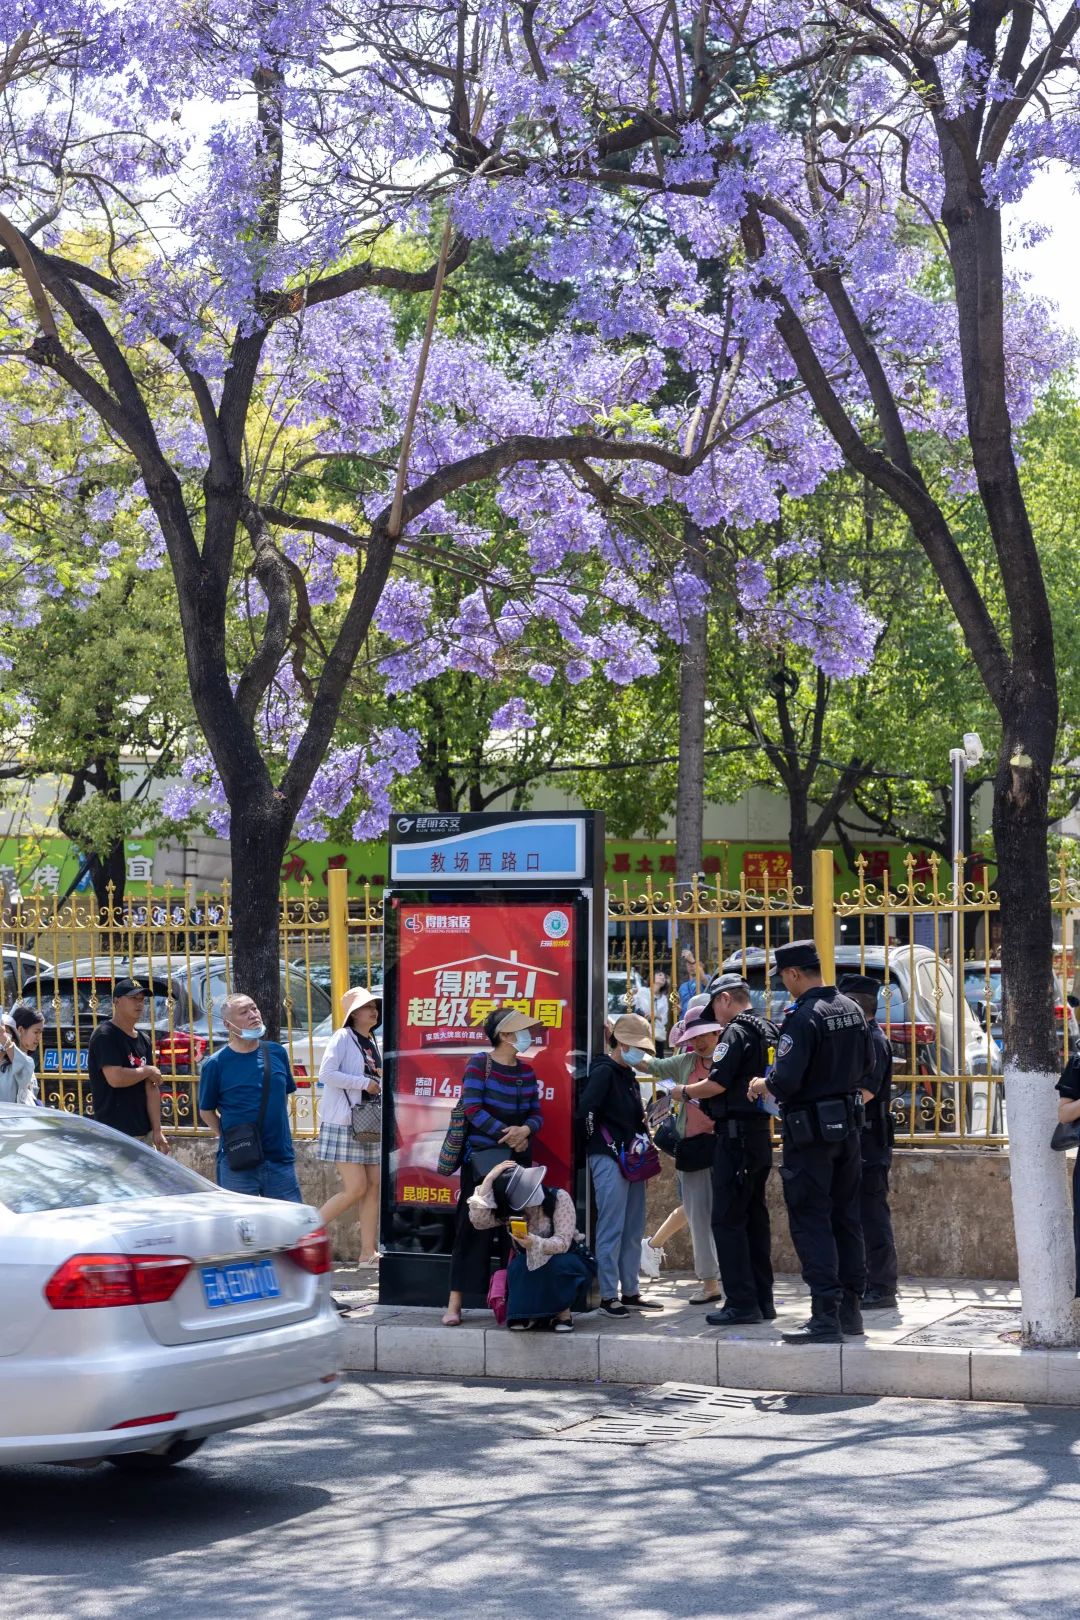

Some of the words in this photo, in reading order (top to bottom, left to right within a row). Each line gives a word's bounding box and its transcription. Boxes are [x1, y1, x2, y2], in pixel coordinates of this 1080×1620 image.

[416, 817, 461, 828] 昆明公交
[430, 852, 540, 873] 教场西路口
[425, 915, 471, 928] 得胜家居
[434, 970, 537, 998] 得胜5.1
[416, 1077, 433, 1086] 活动
[439, 1077, 462, 1098] 4月
[415, 1087, 432, 1096] 时间
[403, 1186, 451, 1203] 昆明5店
